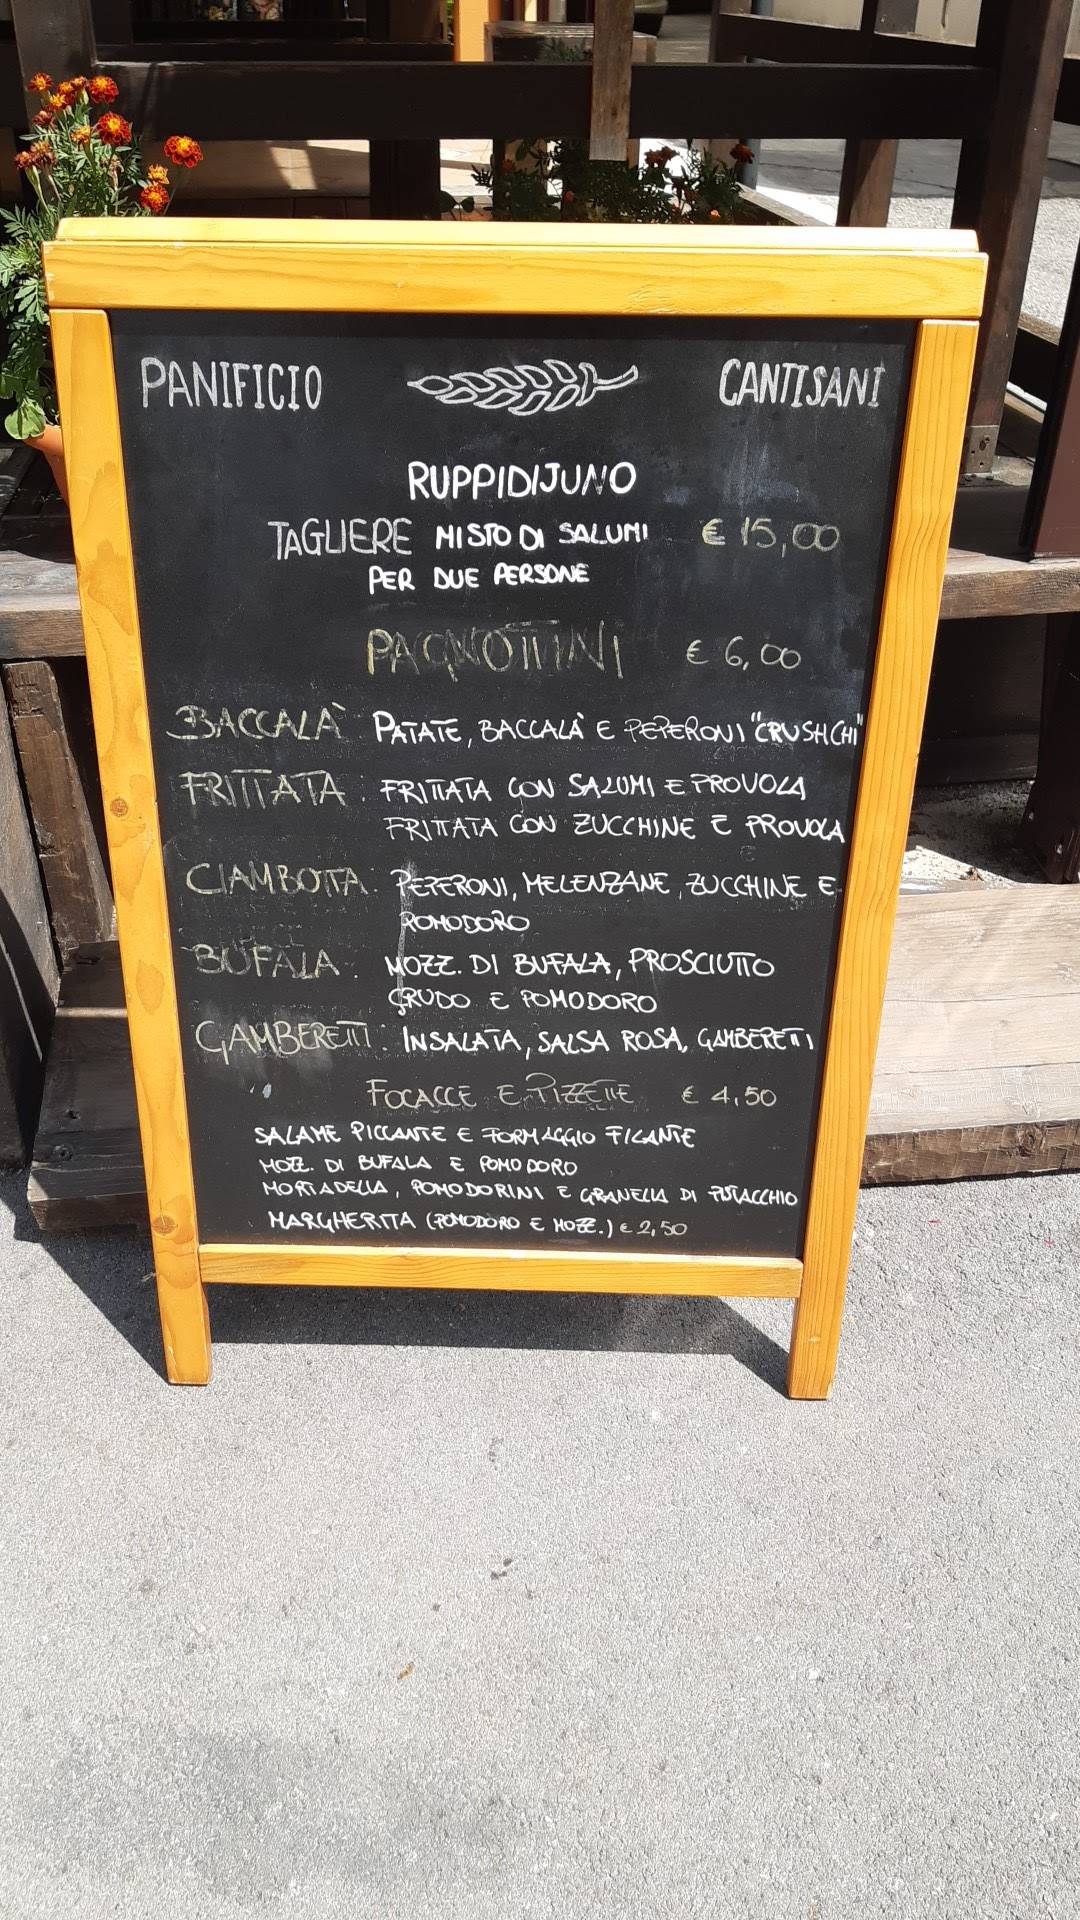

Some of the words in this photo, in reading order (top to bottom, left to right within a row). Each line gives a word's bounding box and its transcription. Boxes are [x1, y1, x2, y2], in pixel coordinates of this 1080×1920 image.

[141, 357, 322, 411] PANIFICIO
[719, 358, 886, 408] CANTISANI
[408, 461, 637, 500] RUPPIDIJUNO
[268, 518, 412, 560] TAGLIERE
[436, 523, 511, 549] MISTO
[519, 524, 544, 550] DI
[558, 522, 648, 545] SALUMI
[701, 518, 726, 546] €
[740, 517, 840, 557] 15,00
[369, 565, 415, 594] PER
[434, 567, 479, 589] DUE
[494, 562, 590, 586] PERSONE
[686, 639, 709, 664] €
[725, 636, 801, 671] 6,00
[372, 710, 472, 748] PATATE,
[479, 712, 585, 742] BACCALÀ
[597, 720, 615, 740] E
[624, 715, 745, 743] PEPERONI
[380, 777, 492, 804] FRITTATA
[508, 776, 554, 799] CON
[568, 773, 655, 799] SALUMI
[664, 779, 685, 795] E
[690, 772, 806, 800] PROVOLA
[383, 816, 498, 842] FRITTATA
[509, 814, 556, 833] CON
[573, 813, 696, 839] ZUCCHINE
[711, 815, 731, 835] E
[746, 815, 845, 843] PROVOLA
[390, 869, 517, 901] PEPERONI,
[819, 876, 836, 895] E
[400, 910, 530, 933] POMODORO
[385, 954, 461, 977] MOZZ.
[470, 954, 499, 975] DI
[513, 952, 620, 981] BUFALA,
[628, 948, 774, 977] PROSCIUTTO
[490, 993, 509, 1009] E
[522, 989, 657, 1013] POMODORO
[402, 1026, 530, 1060] INSALATA,
[538, 1030, 609, 1055] SALSA
[621, 1027, 688, 1053] ROSA,
[698, 1028, 813, 1050] GAMBERETTI
[366, 1079, 477, 1109] FOCACCE
[497, 1084, 519, 1105] E
[526, 1072, 634, 1105] PIZZETTE
[681, 1085, 699, 1103] €
[711, 1085, 776, 1107] 4,50
[254, 1124, 341, 1145] SALAME
[351, 1121, 446, 1143] PICCANTE
[457, 1128, 473, 1142] E
[482, 1127, 595, 1147] FORMAGGIO
[259, 1156, 314, 1174] MOZZ.
[326, 1158, 344, 1172] DI
[359, 1154, 432, 1172] BUFALA
[450, 1156, 465, 1171] E
[480, 1155, 578, 1175] POMODORO
[411, 1179, 544, 1200] POMODORINI
[559, 1186, 571, 1198] E
[580, 1187, 668, 1205] GRANELLA
[680, 1188, 697, 1201] DI
[708, 1185, 798, 1205] PISTACCHIO
[268, 1210, 416, 1233] MARGHERITA
[426, 1212, 520, 1231] (POMODORO
[529, 1217, 545, 1231] E
[620, 1221, 632, 1234] €
[636, 1219, 688, 1237] 2,50
